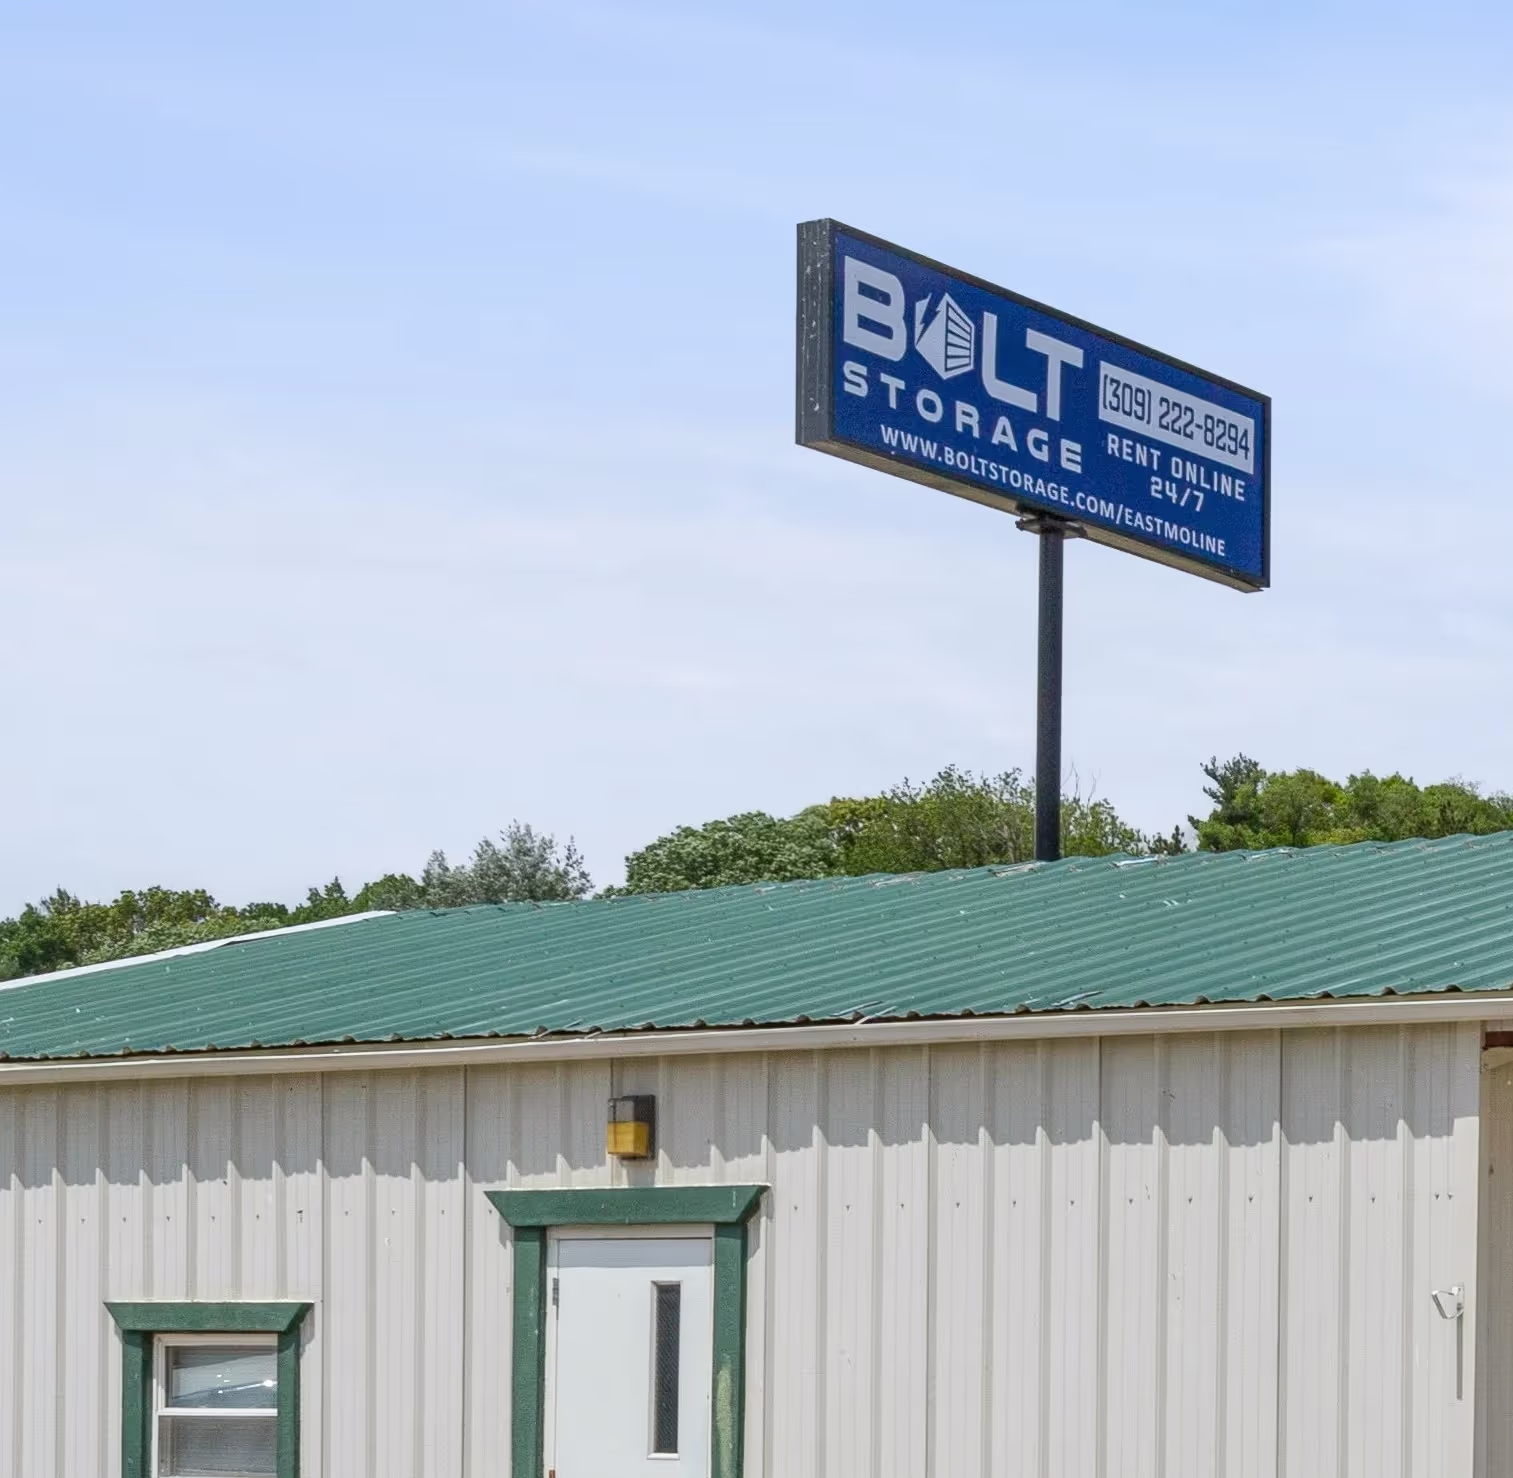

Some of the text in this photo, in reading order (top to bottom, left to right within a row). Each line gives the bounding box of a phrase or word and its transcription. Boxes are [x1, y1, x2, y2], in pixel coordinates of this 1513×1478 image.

[843, 360, 1083, 474] STORAGE
[1102, 373, 1250, 461] (309) 222-8294
[880, 423, 1226, 557] WWW.BOLTSTORAGE.COM/EASTMOLINE
[1107, 432, 1246, 502] RENT ONLINE
[1150, 475, 1205, 513] 24/7
